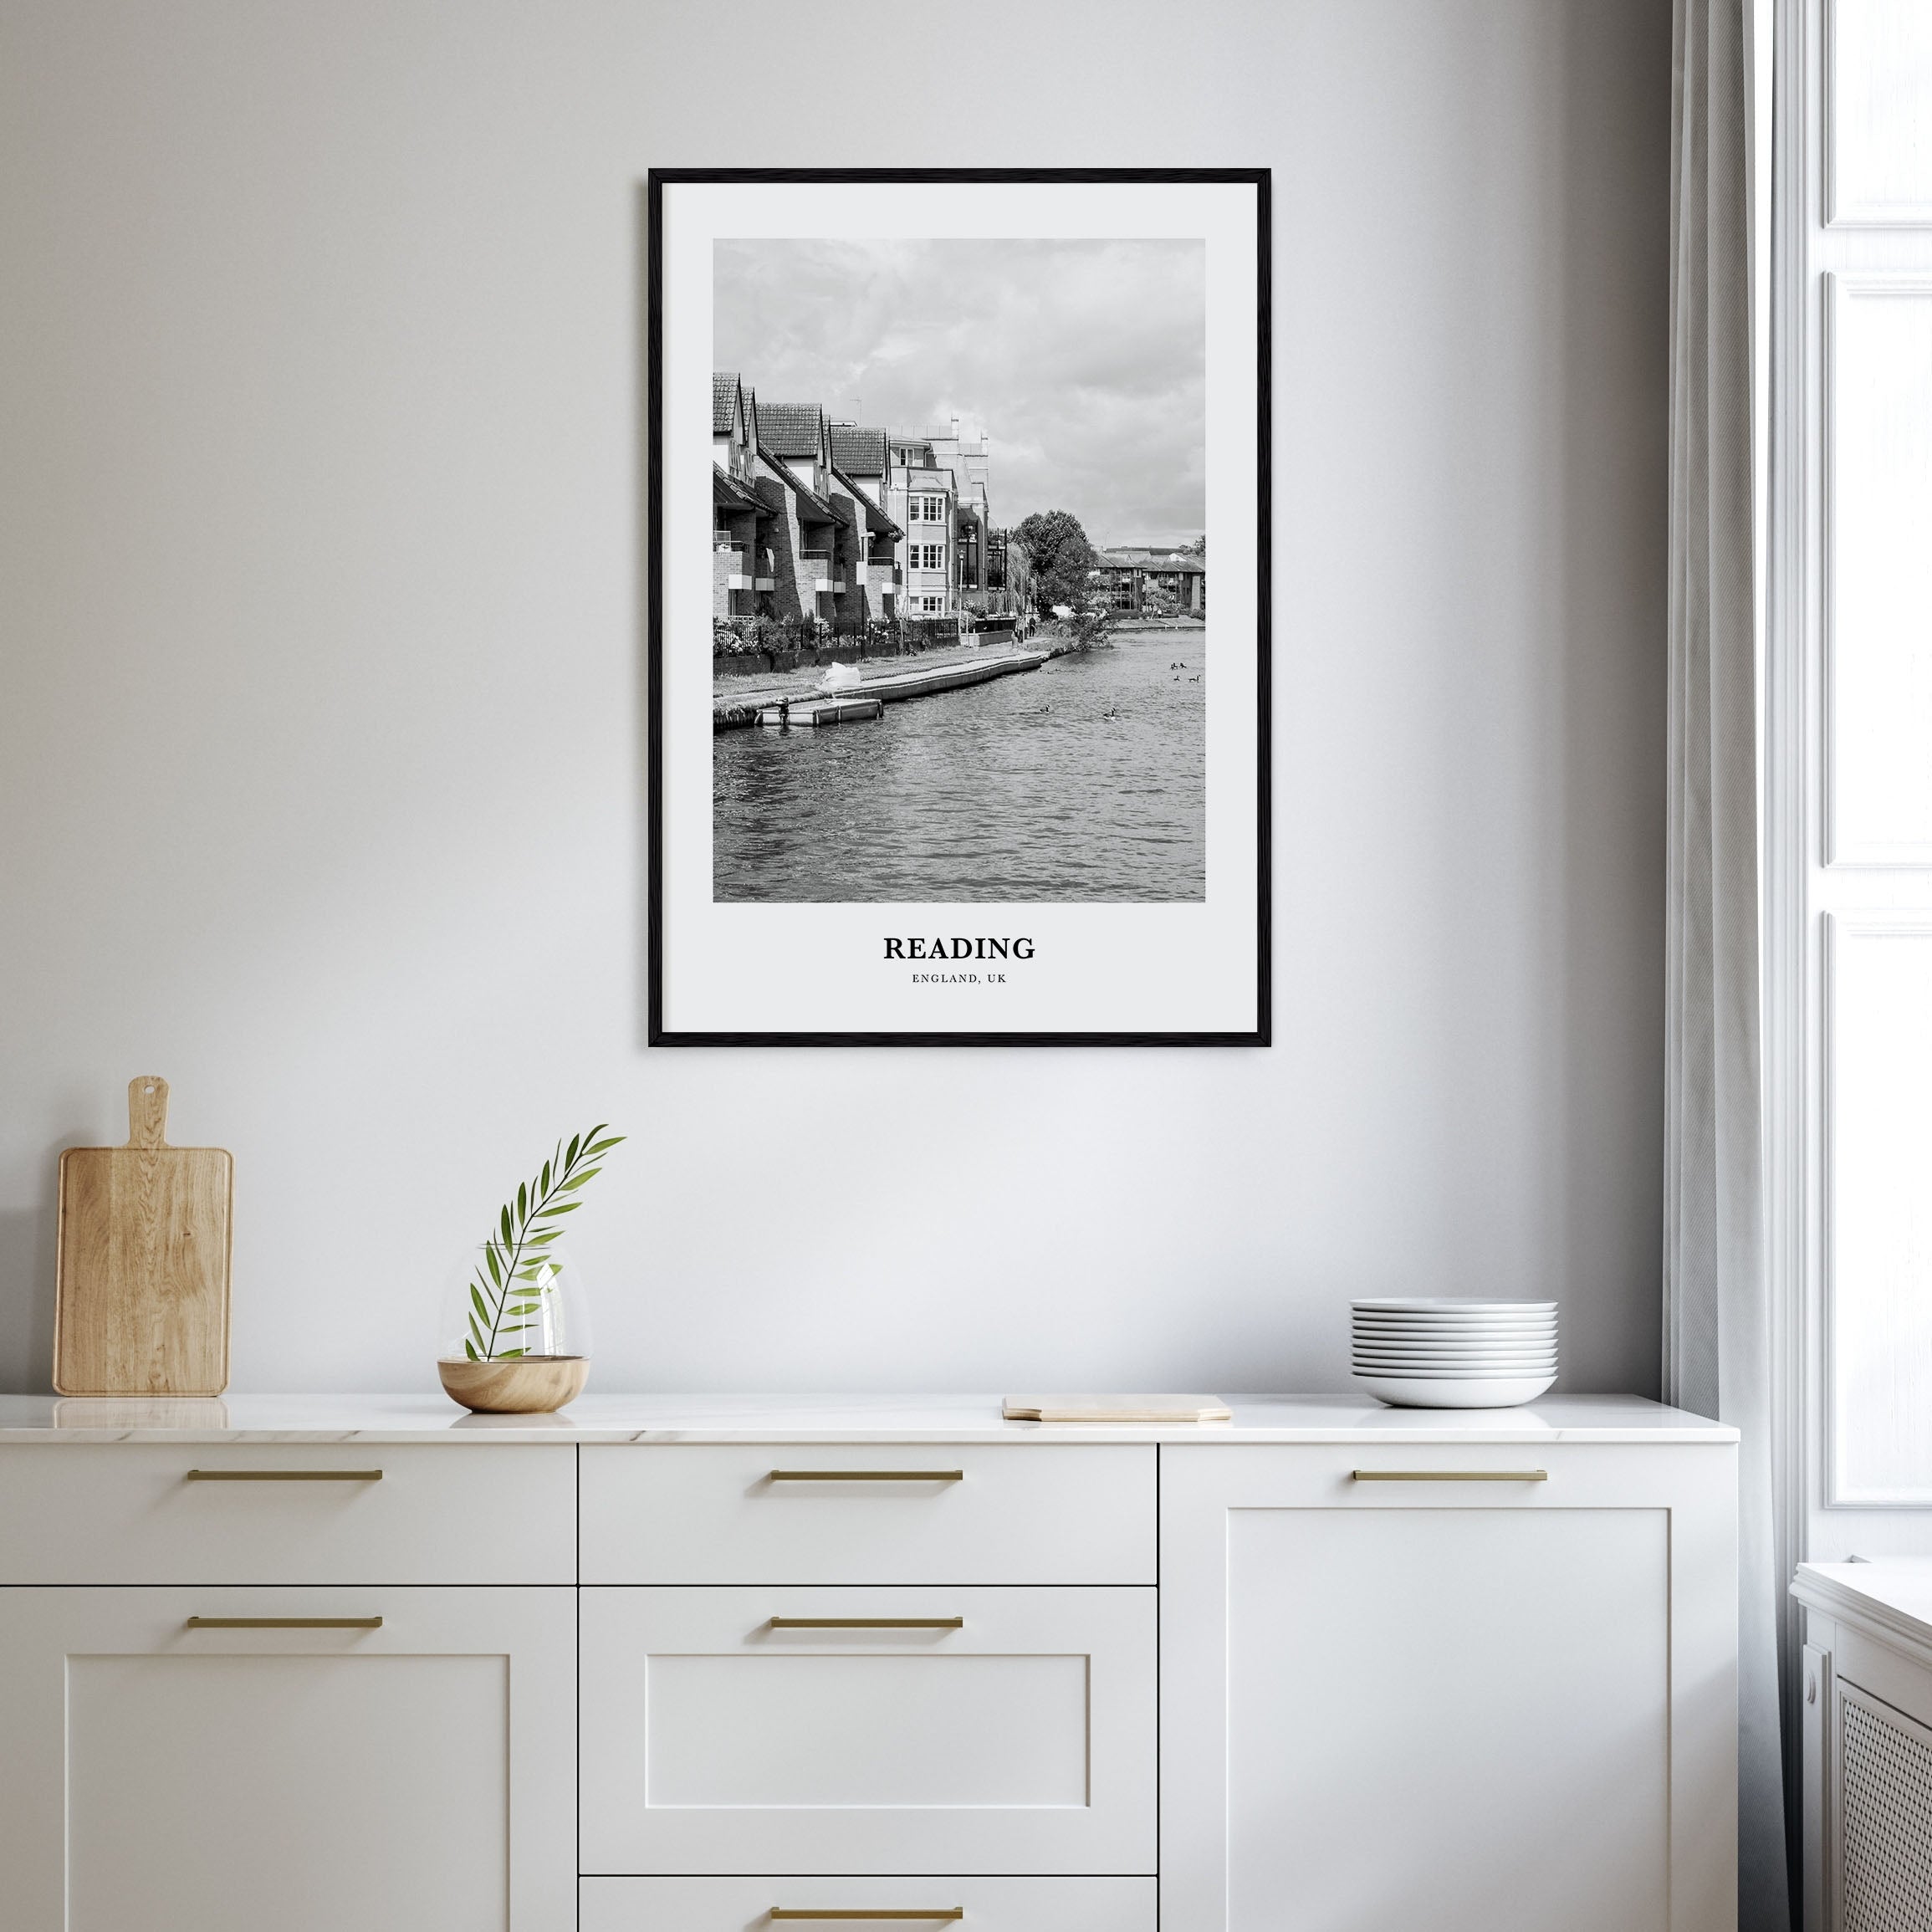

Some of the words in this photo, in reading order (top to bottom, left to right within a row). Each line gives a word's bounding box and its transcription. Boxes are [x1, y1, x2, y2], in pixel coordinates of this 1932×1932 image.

[883, 938, 1035, 959] READING
[912, 974, 981, 984] ENGLAND,
[988, 974, 1006, 983] UK
